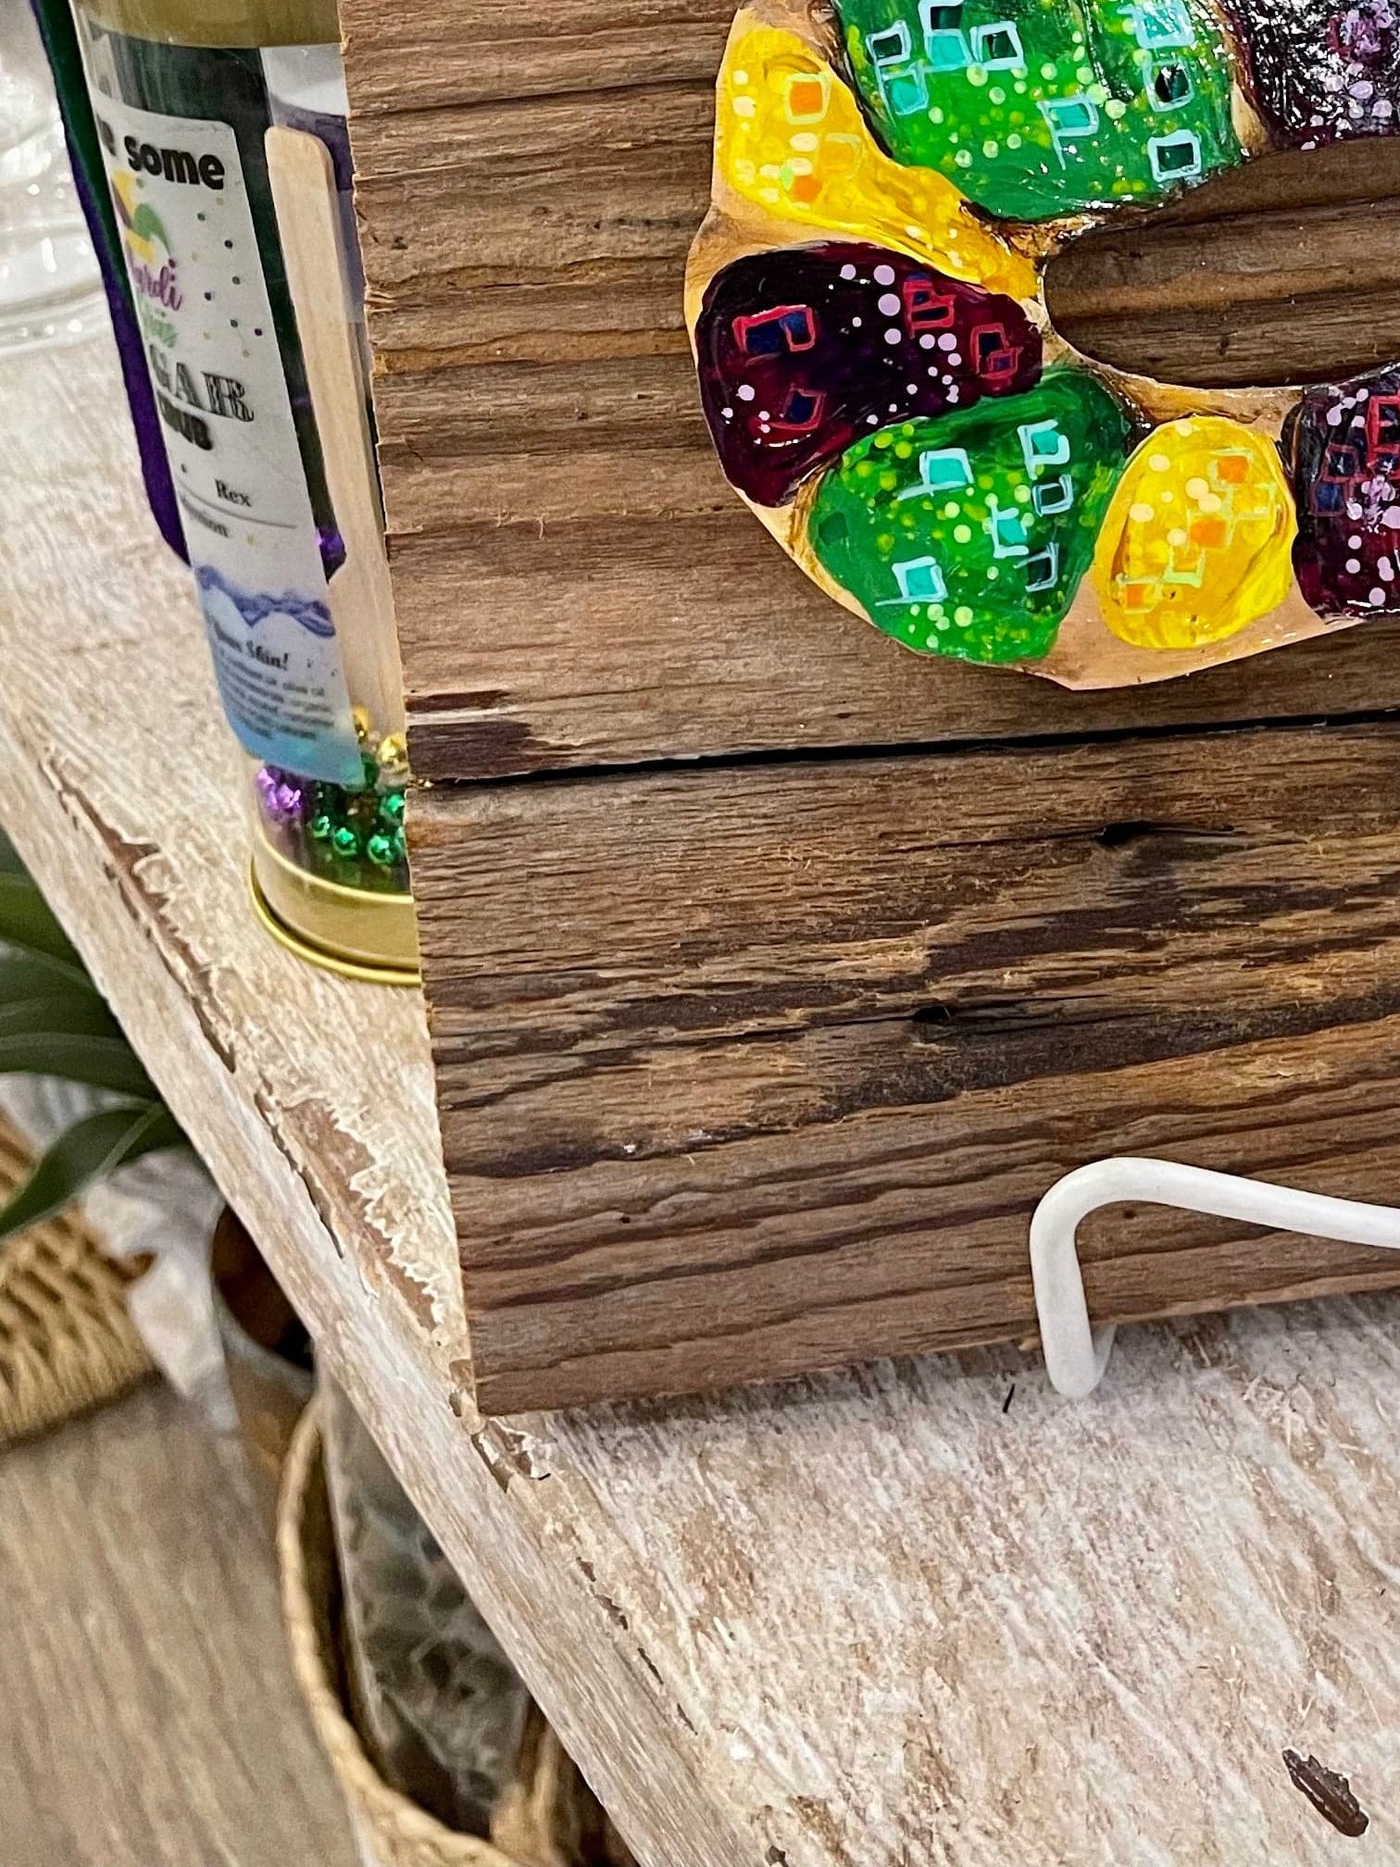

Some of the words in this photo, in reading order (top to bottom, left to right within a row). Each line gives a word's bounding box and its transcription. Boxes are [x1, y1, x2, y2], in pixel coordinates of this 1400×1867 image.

[124, 135, 225, 190] some
[150, 344, 255, 423] GAR
[215, 478, 252, 508] Rex
